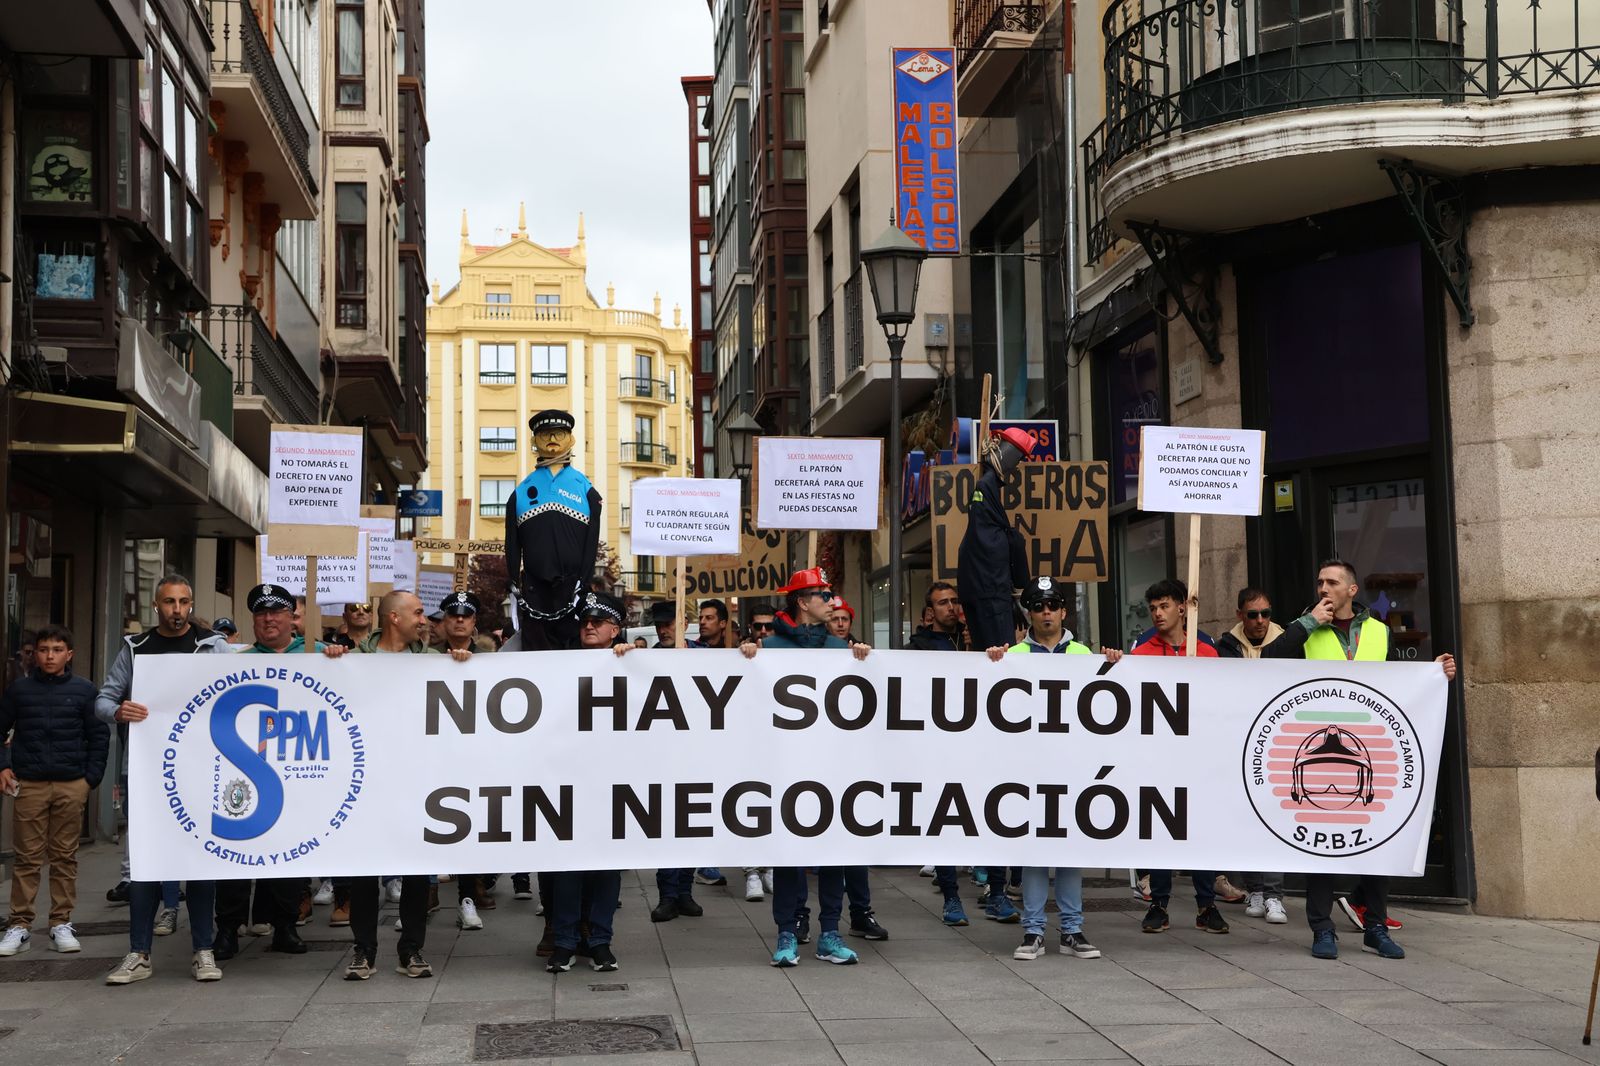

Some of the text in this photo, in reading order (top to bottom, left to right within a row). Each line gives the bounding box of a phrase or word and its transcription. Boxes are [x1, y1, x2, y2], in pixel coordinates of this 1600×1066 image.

[935, 64, 942, 74] 3
[928, 102, 956, 250] BOLSOS
[308, 448, 356, 456] MANDAMIENTO
[1176, 443, 1208, 451] PATRÓN
[296, 459, 338, 468] TOMARÁS
[1158, 454, 1196, 462] DECRETAR
[810, 464, 842, 472] PATRÓN
[1160, 467, 1199, 475] PODAMOS
[276, 472, 313, 480] DECRETO
[774, 478, 820, 486] DECRETARÁ
[1182, 480, 1230, 488] AYUDARNOS
[934, 464, 1108, 515] BOBEROS
[558, 488, 582, 504] POLICÍA
[1184, 492, 1222, 500] AHORRAR
[289, 498, 338, 507] EXPEDIENTE
[656, 508, 687, 517] PATRÓN
[690, 510, 730, 518] REGULARÁ
[656, 522, 702, 530] CUADRANTE
[1015, 513, 1037, 536] N
[415, 540, 451, 550] POLICÍAS
[468, 544, 506, 552] BOMBERO
[936, 519, 1106, 580] LHA
[672, 553, 786, 595] SOLUCIÓN
[425, 661, 1190, 736] NO HAY SOLUCIÓN
[1253, 688, 1414, 790] SINDICATO PROFESIONAL BOMBEROS ZAMORA
[162, 667, 365, 834] SINDICATO PROFESIONAL DE POLICÍAS MUNICIPALES
[213, 754, 221, 811] ZAMORA
[423, 766, 1188, 845] SIN NEGOCIACIÓN
[1293, 825, 1372, 850] S.P.B.Z.
[204, 837, 320, 866] CASTILLA Y LEÓN
